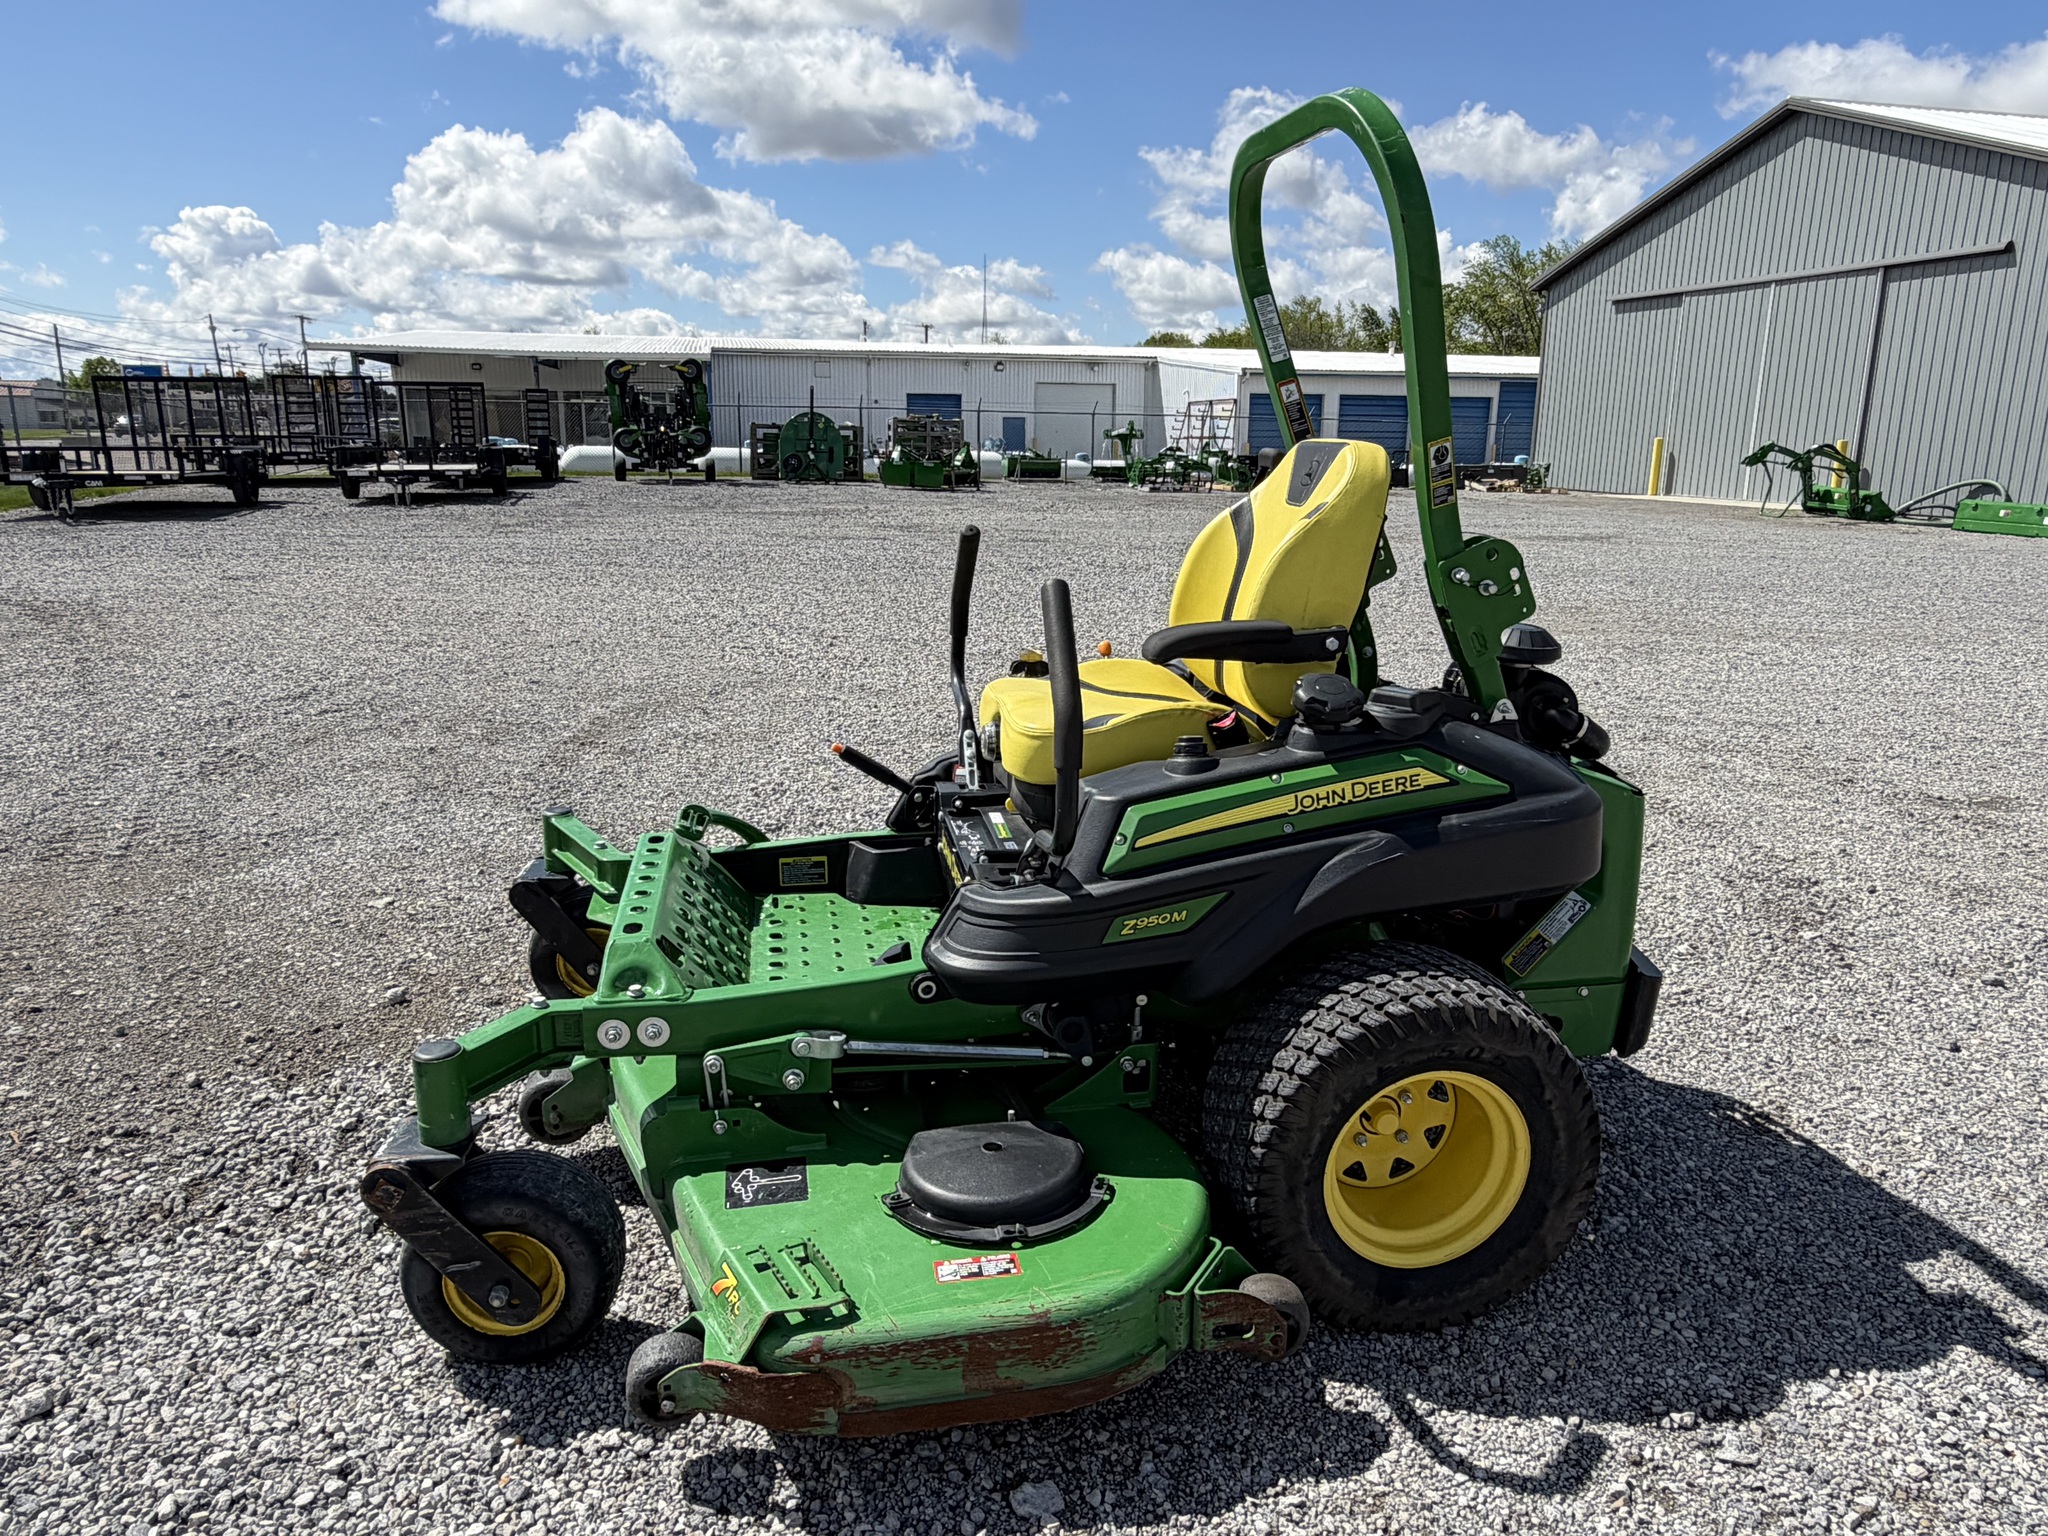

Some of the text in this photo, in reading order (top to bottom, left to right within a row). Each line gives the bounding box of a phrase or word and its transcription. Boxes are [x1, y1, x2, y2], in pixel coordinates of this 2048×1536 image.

[1287, 773, 1422, 813] JOHN DEERE
[1120, 910, 1188, 936] Z950M
